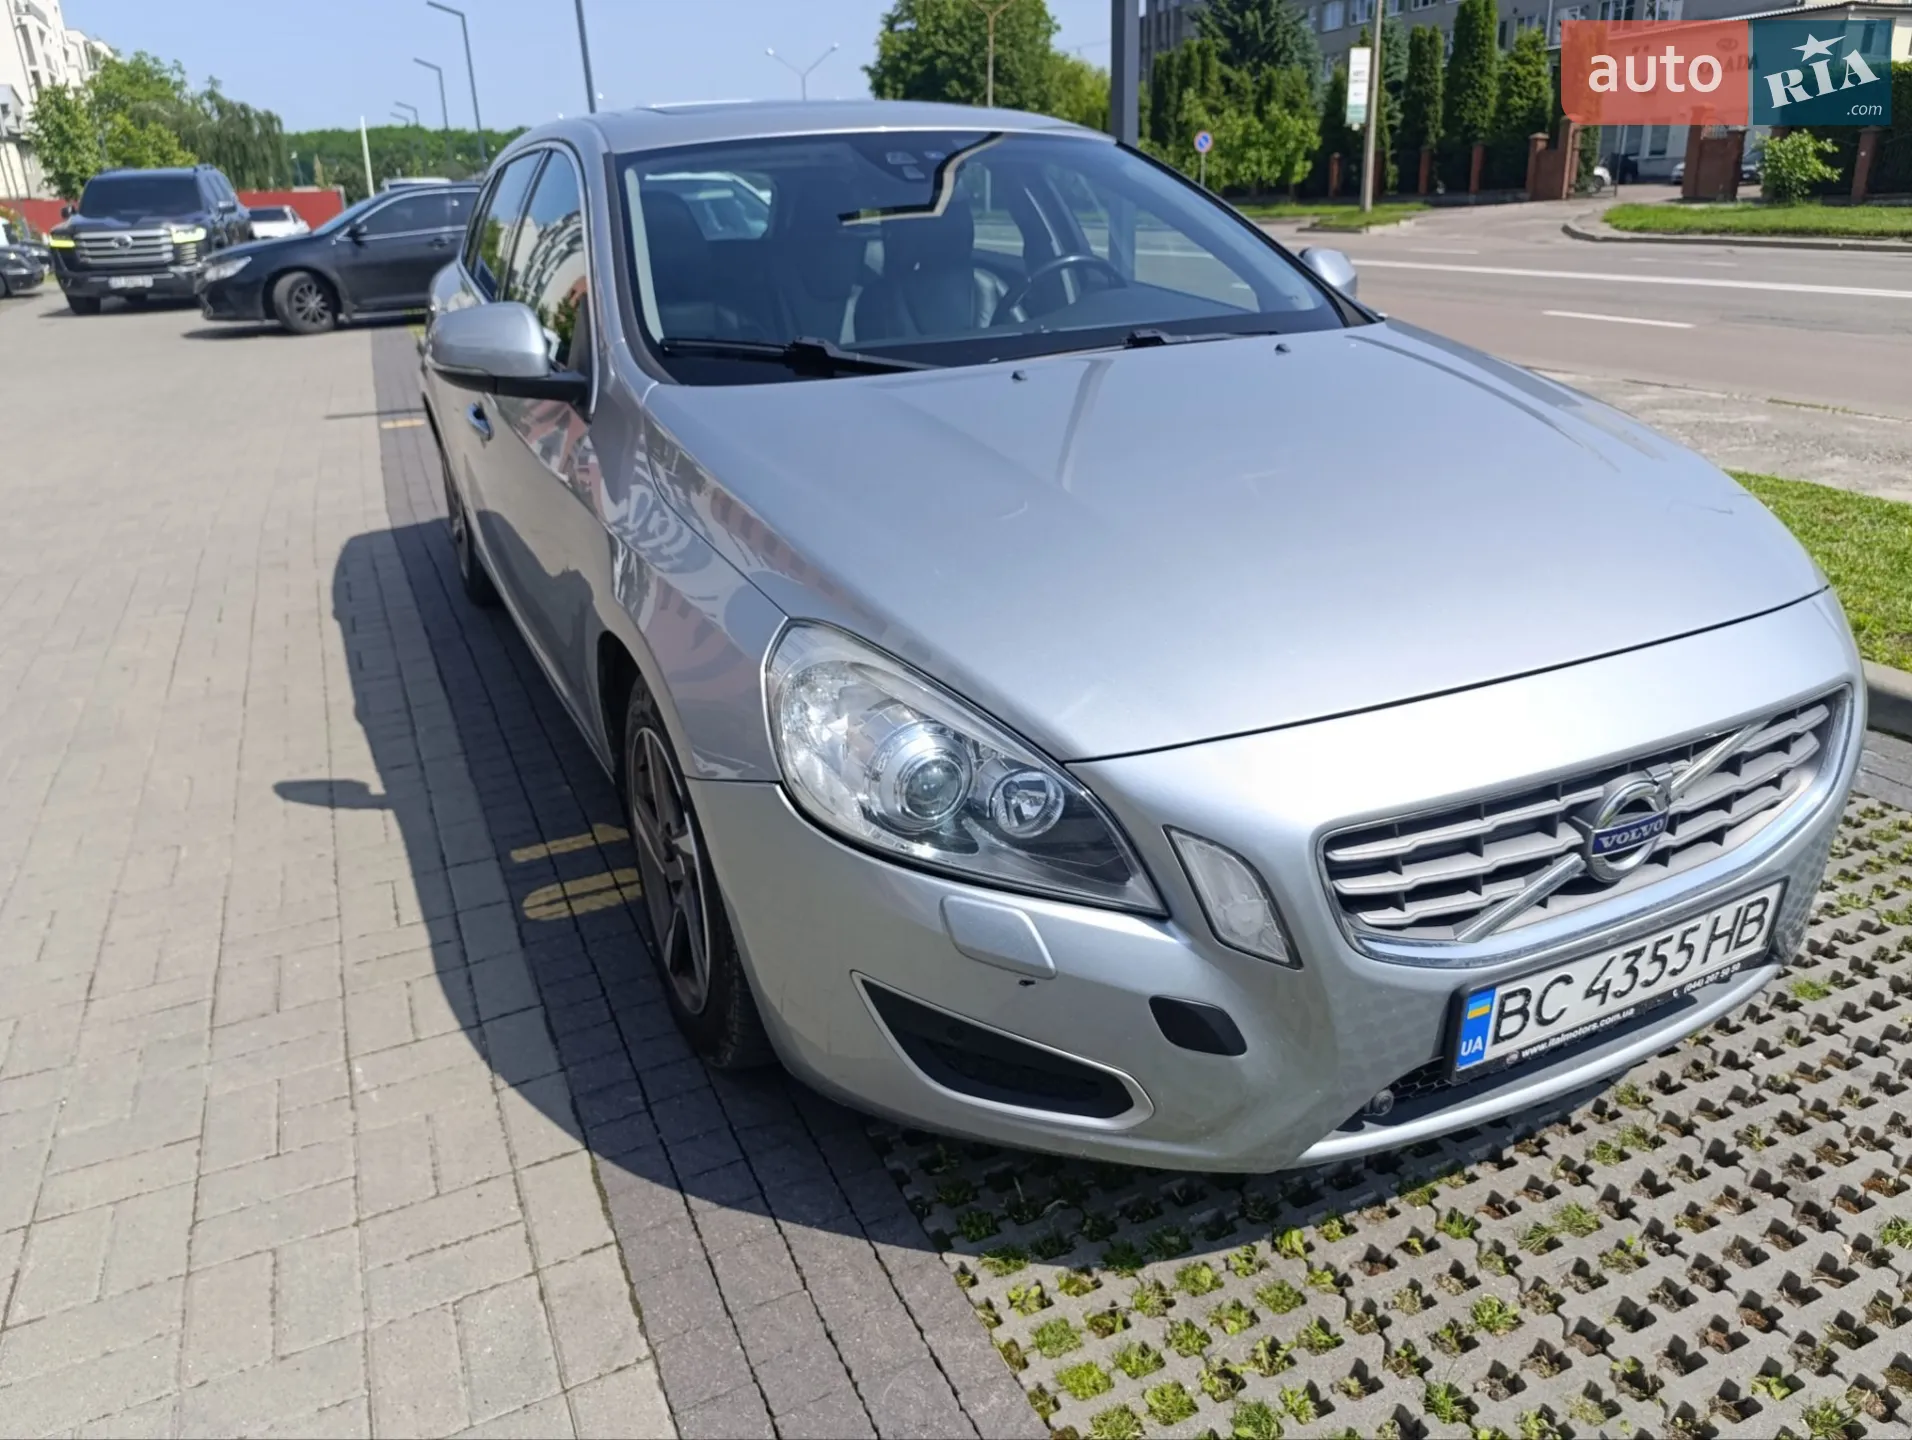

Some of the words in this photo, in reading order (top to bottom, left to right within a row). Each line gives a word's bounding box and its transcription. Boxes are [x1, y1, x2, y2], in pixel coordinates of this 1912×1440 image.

[1598, 818, 1665, 849] VOLVO
[1491, 974, 1574, 1046] BC
[1582, 923, 1700, 1007] 4355
[1701, 896, 1770, 965] HB
[1460, 1035, 1484, 1057] UA
[1520, 1007, 1636, 1058] www.italmotors.com.ua
